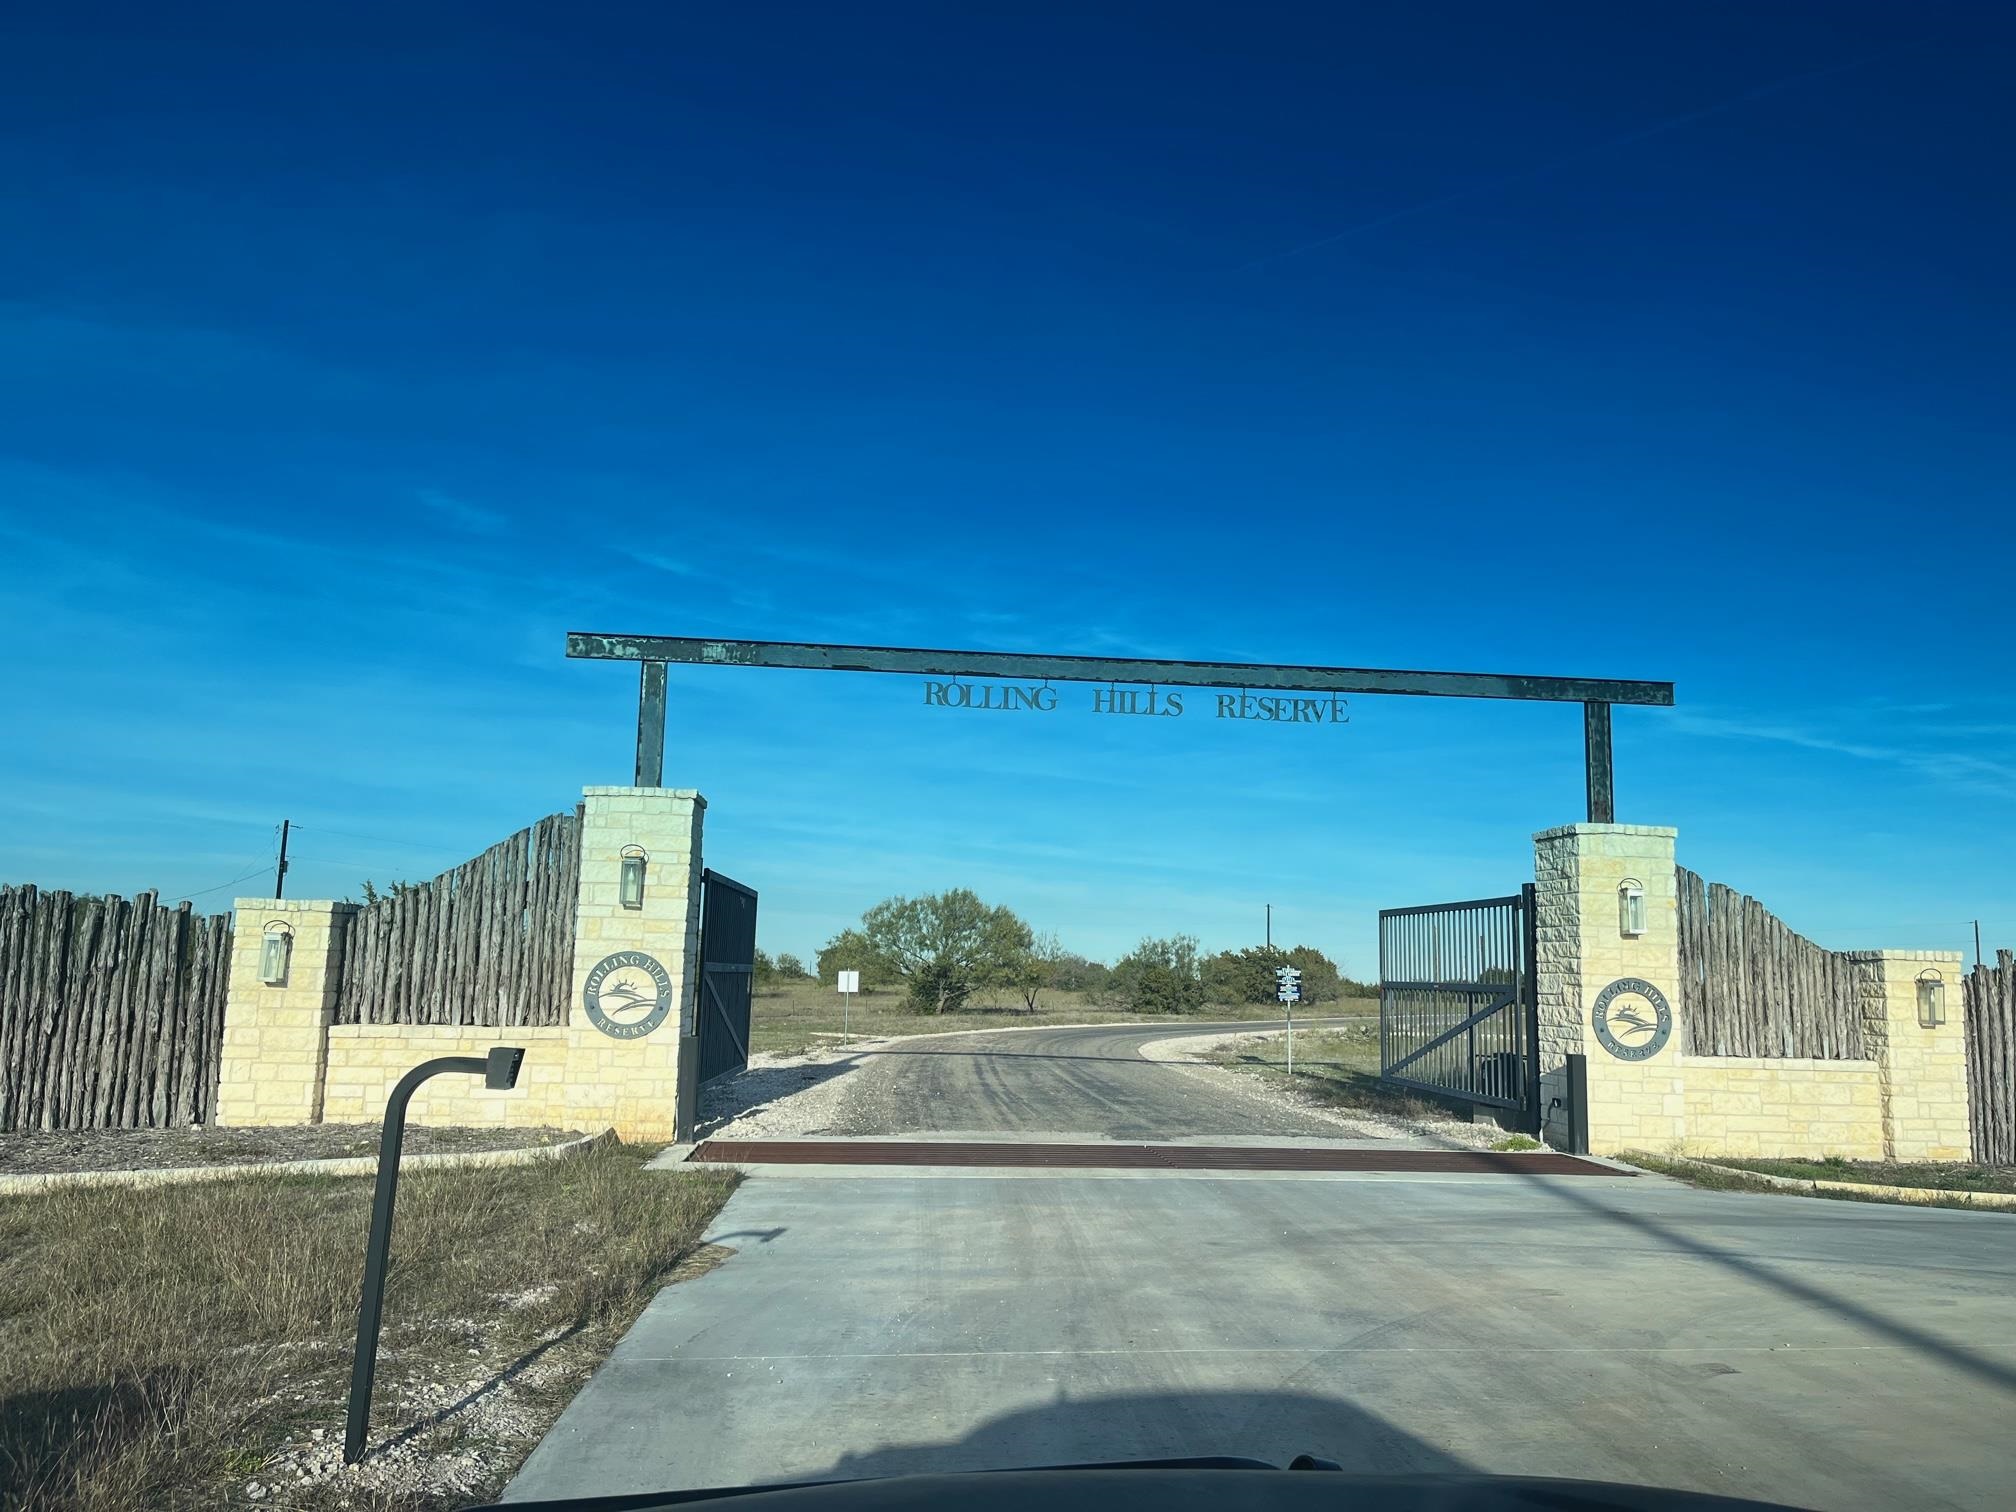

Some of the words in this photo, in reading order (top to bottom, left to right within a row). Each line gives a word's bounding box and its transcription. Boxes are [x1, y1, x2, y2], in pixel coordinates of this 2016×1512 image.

[923, 681, 1057, 711] ROLLING
[1093, 688, 1183, 717] HILLS
[1216, 694, 1350, 723] RESERVE
[587, 955, 640, 996] ROLLING
[643, 959, 670, 998] HILLS
[1595, 981, 1640, 1019] ROLLING
[1644, 985, 1669, 1022] HILLS
[597, 1018, 655, 1036] RESERVE
